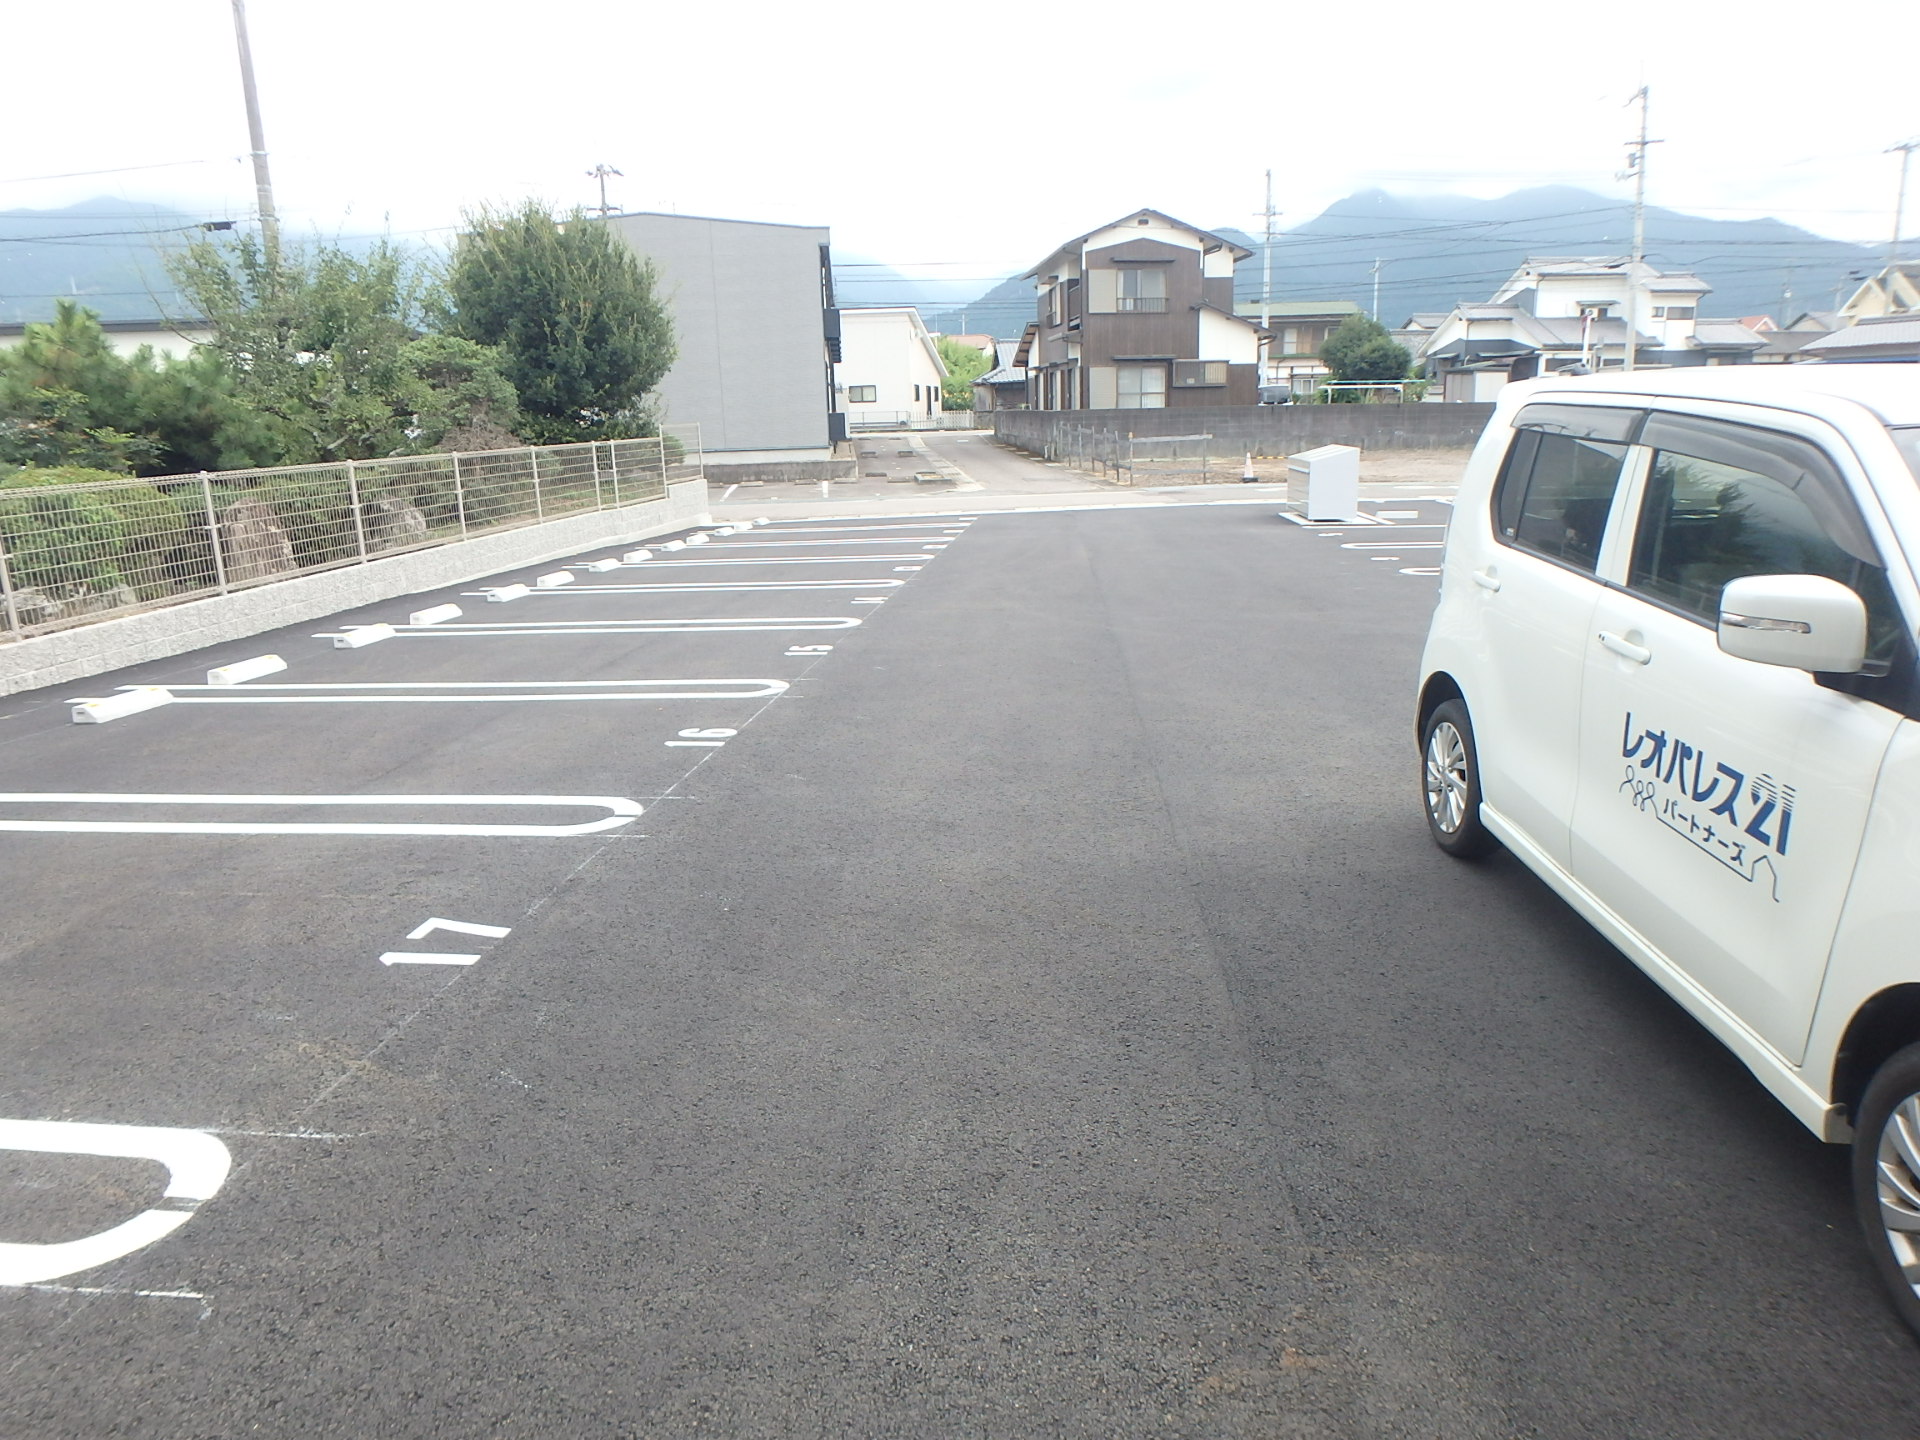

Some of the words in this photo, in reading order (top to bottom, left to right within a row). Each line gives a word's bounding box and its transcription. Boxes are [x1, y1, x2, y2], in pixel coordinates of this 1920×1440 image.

[784, 644, 834, 656] 15
[664, 728, 738, 747] 16
[1622, 712, 1796, 856] レオパレス21
[1664, 799, 1746, 867] パートナーズ
[378, 917, 512, 966] 17
